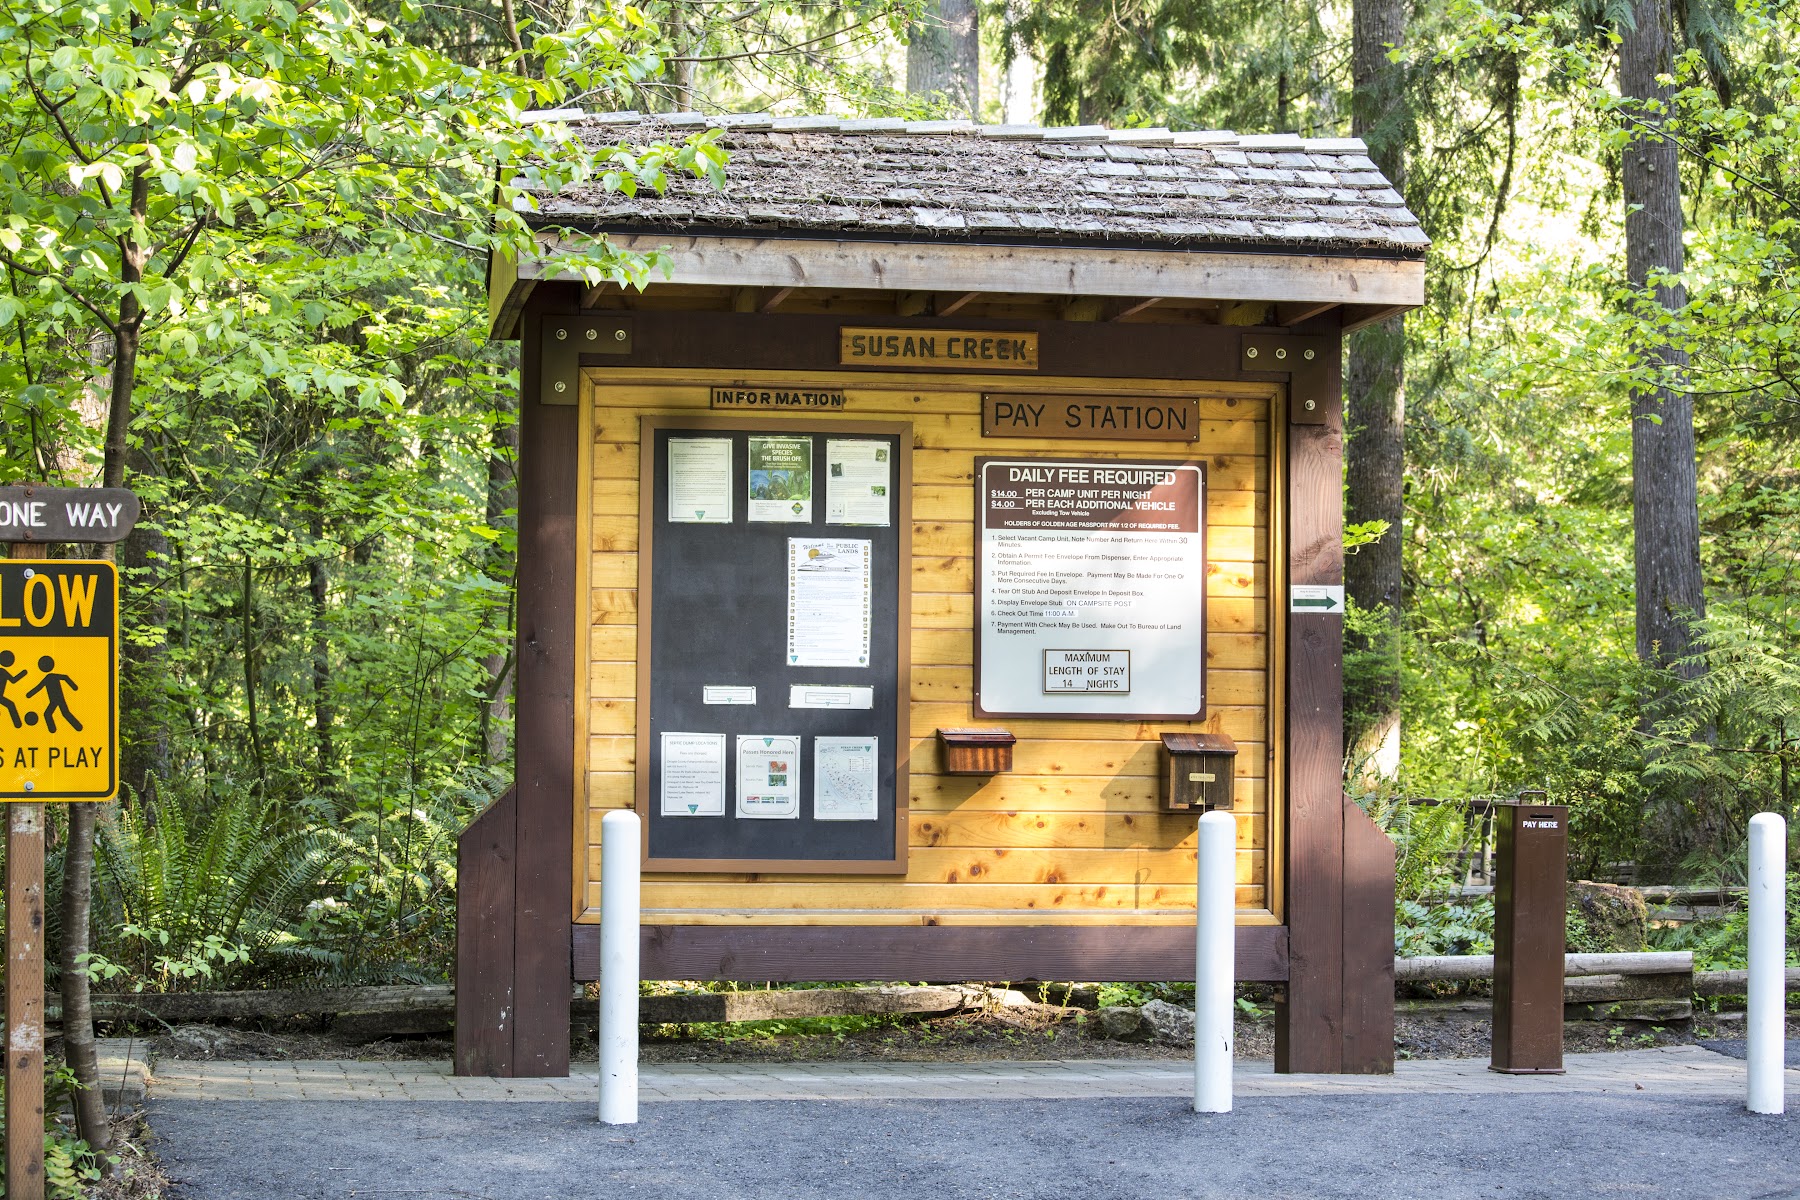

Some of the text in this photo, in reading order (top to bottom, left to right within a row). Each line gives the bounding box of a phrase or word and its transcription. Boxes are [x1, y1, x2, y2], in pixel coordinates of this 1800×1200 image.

[852, 335, 1026, 360] SUSAN CREEK
[716, 391, 841, 406] INFORMATION
[995, 402, 1187, 430] PAY STATION
[1009, 468, 1176, 486] DAILY FEE REQUIRED
[1025, 488, 1045, 497] PER
[1047, 489, 1075, 498] CAMP
[1077, 490, 1099, 498] UNIT
[1102, 490, 1120, 499] PER
[1123, 491, 1152, 500] NIGHT
[1025, 499, 1045, 508] PER
[1047, 500, 1074, 508] EACH
[1076, 500, 1133, 510] ADDITIONAL
[1135, 502, 1176, 510] VEHICLE
[0, 502, 122, 528] ONE WAY
[1064, 653, 1110, 662] MAXIMUM
[1049, 666, 1125, 676] LENGTH OF STAY
[1087, 680, 1119, 688] NIGHTS
[14, 747, 38, 768] AT
[49, 747, 102, 768] PLAY
